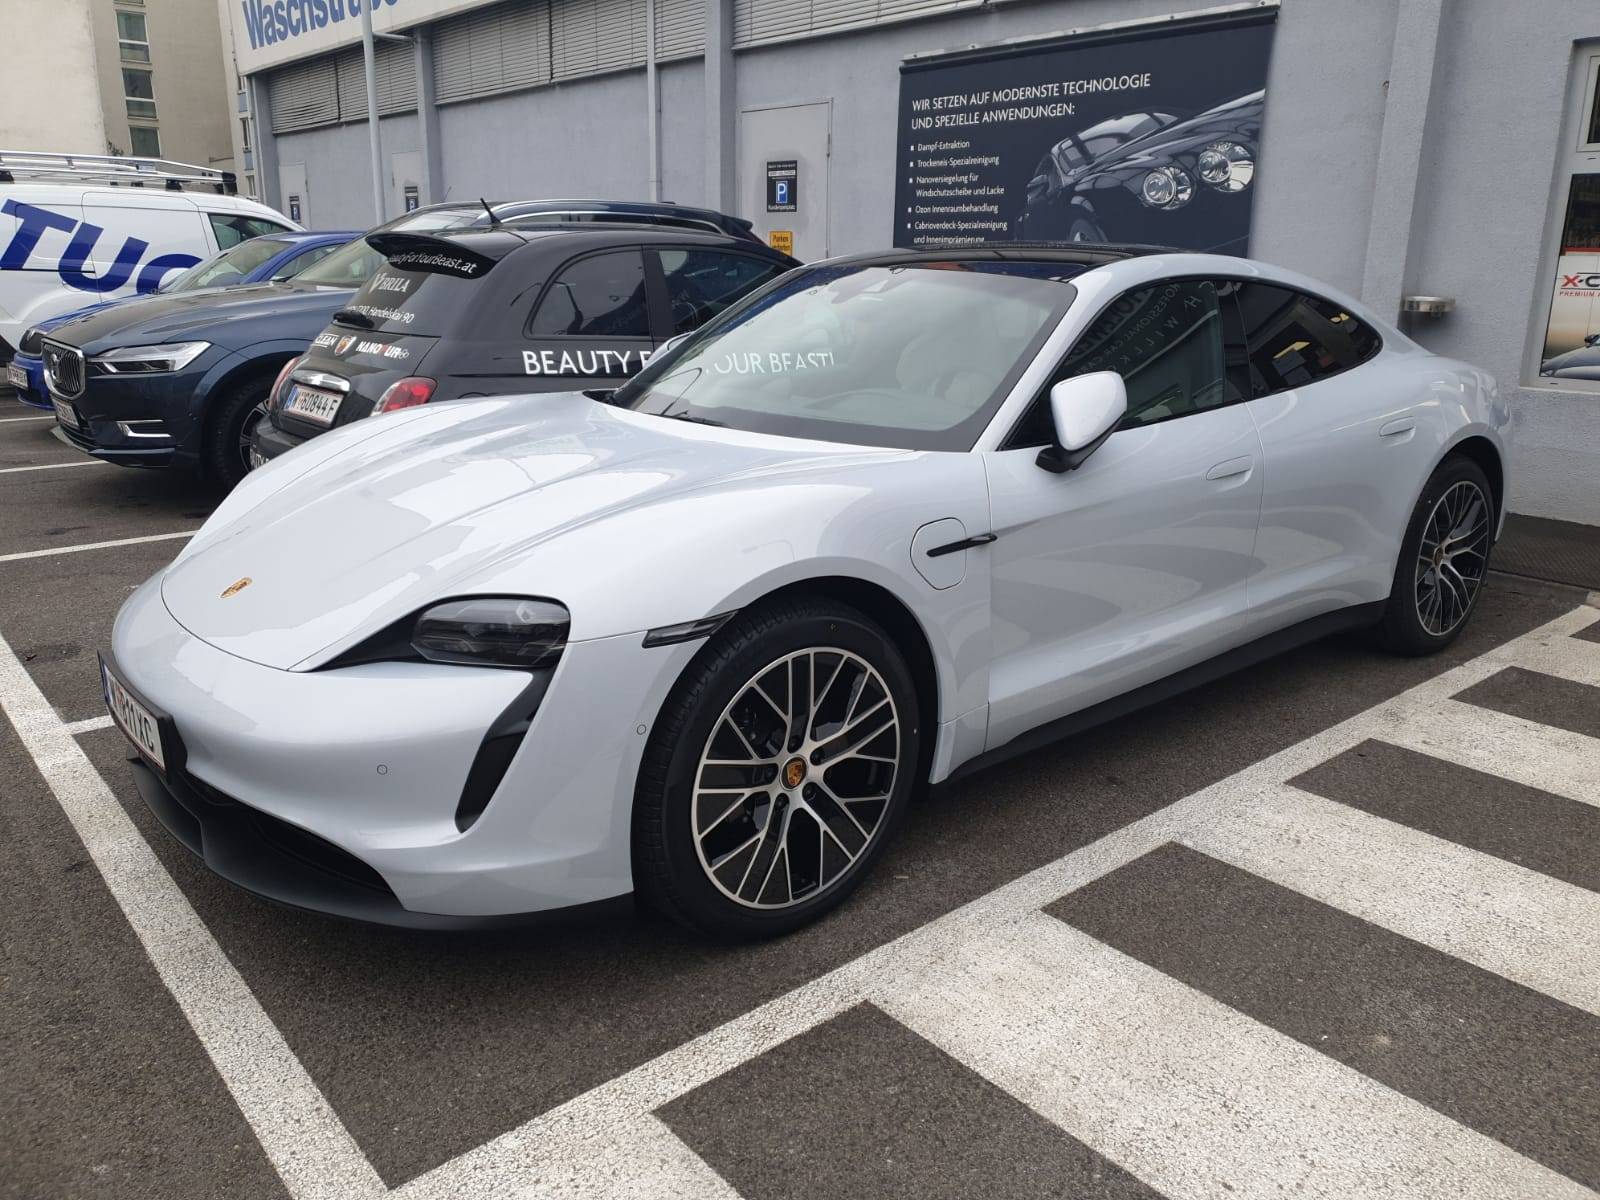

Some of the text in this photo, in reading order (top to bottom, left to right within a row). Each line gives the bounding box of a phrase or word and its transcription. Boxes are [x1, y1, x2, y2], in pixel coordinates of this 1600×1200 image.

[242, 0, 398, 50] Waschstra
[912, 73, 1151, 111] WIR SETZEN AUF MODERNSTE TECHNOLOGIE
[911, 102, 1076, 130] UND SPEZIELLE ANWENDUNGEN:
[917, 140, 970, 153] Dampf-Extraktion
[916, 172, 979, 185] Nanoversiegelung für
[777, 183, 786, 202] P
[916, 185, 1005, 197] Windschutzscheibe und Lacke
[915, 203, 999, 214] Ozon Innenraumbehandlung
[914, 220, 1008, 232] Cabrioverdeck-Spezialreinigung
[913, 235, 925, 244] und
[401, 312, 415, 324] 90
[522, 350, 631, 375] BEAUTY
[705, 352, 764, 374] OUR
